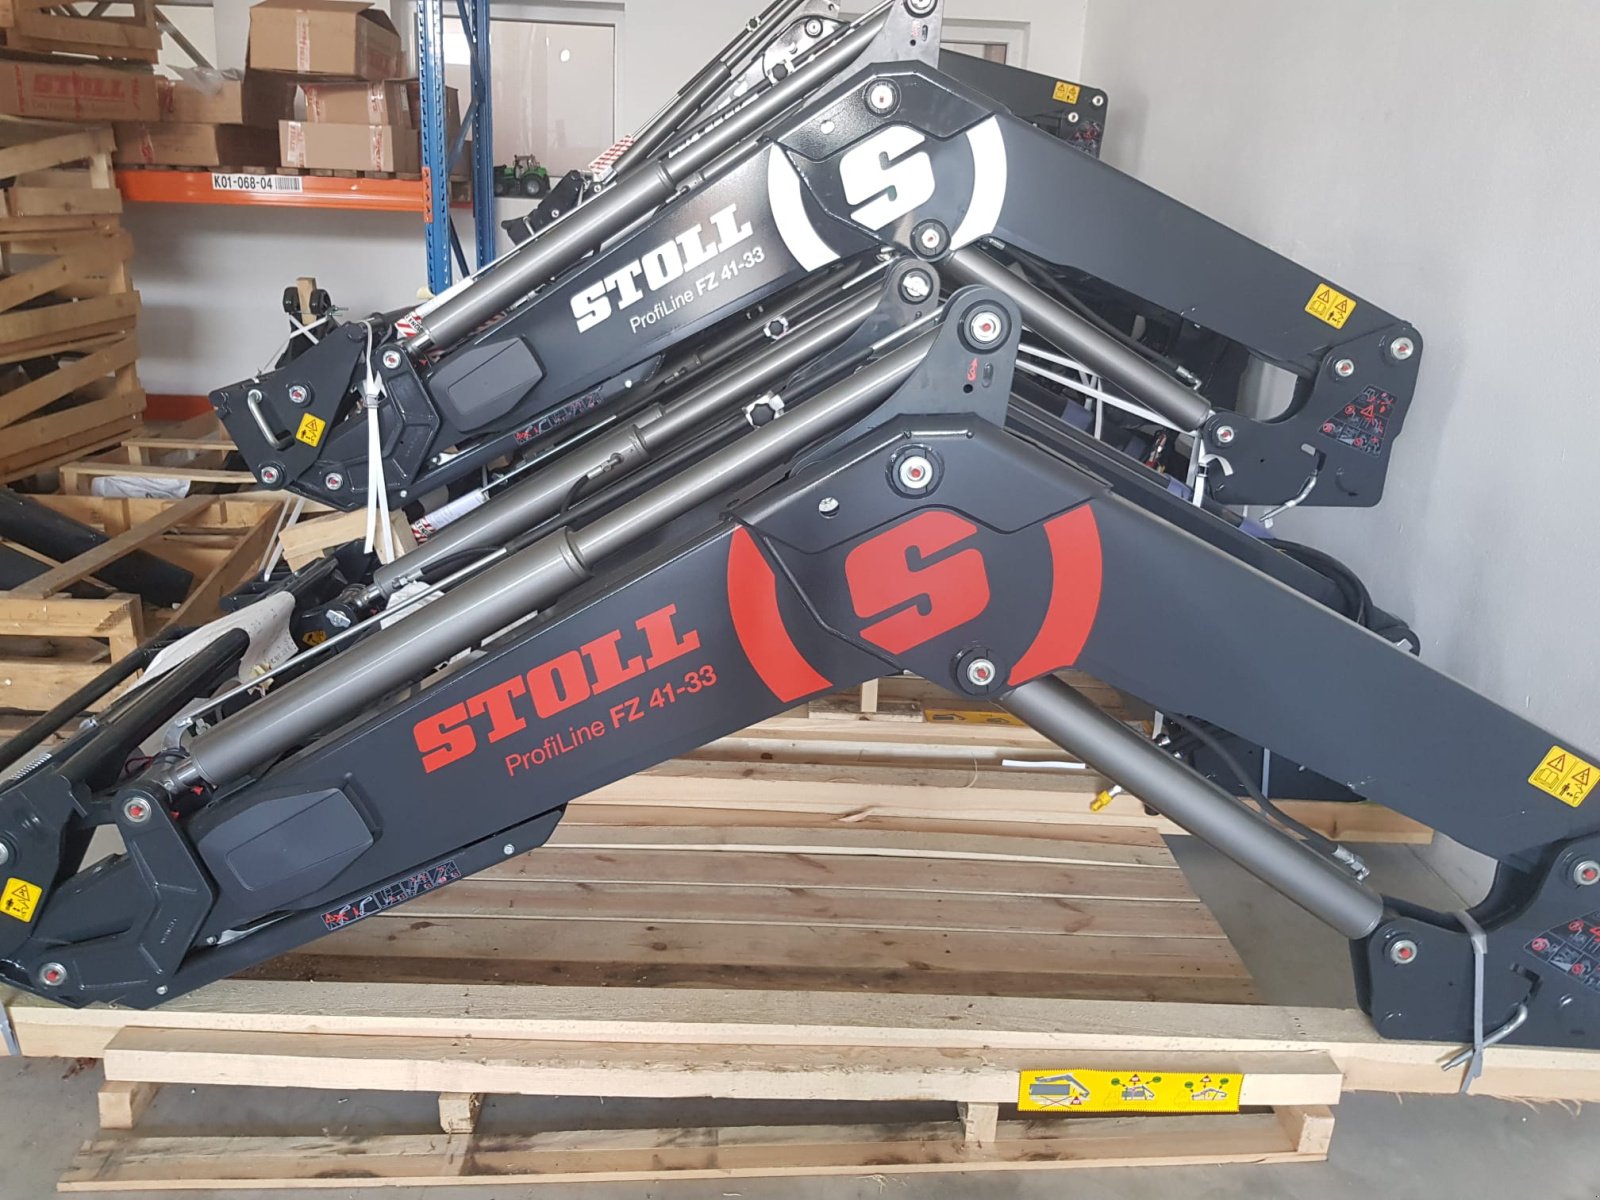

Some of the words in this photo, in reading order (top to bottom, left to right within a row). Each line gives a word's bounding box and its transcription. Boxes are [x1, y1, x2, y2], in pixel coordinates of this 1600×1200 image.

[213, 175, 273, 190] K01-068-04
[838, 125, 936, 231] S
[569, 203, 754, 334] STOLL
[629, 290, 695, 334] ProfiLine
[695, 271, 719, 296] FZ
[720, 246, 765, 281] 41-33
[844, 510, 991, 655] S
[412, 602, 701, 774] STOLL
[504, 718, 607, 777] ProfiLine
[609, 696, 645, 729] FZ
[649, 664, 718, 709] 41-33
